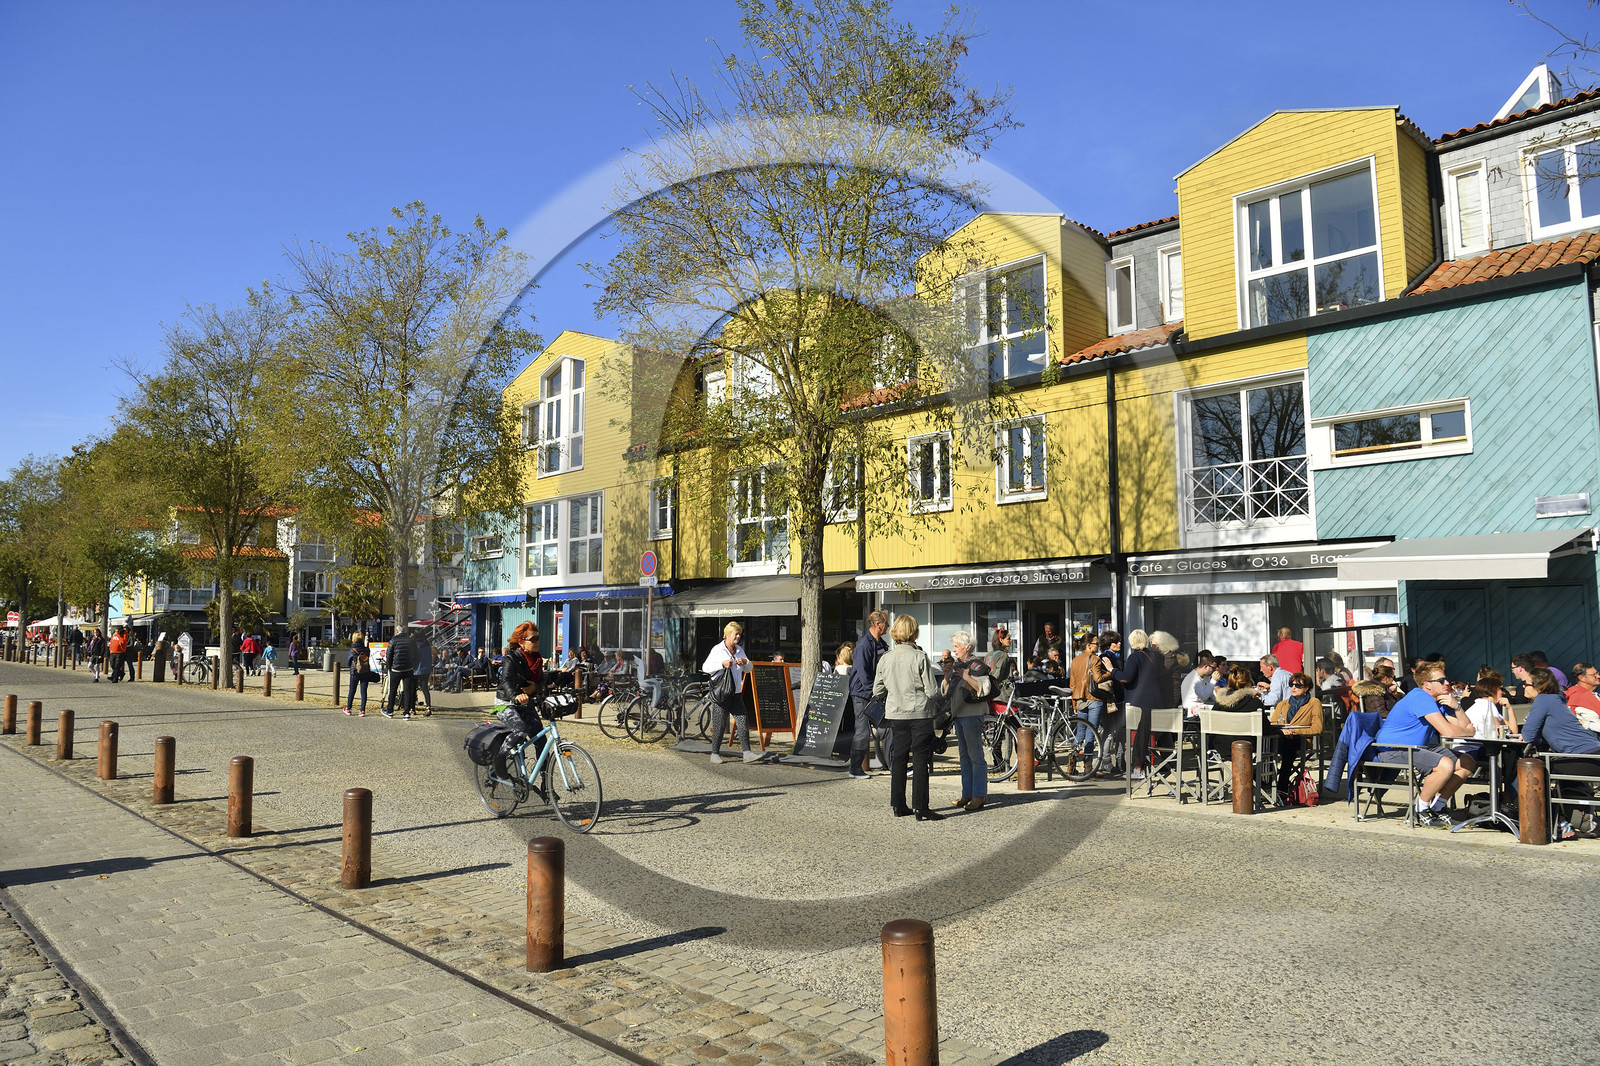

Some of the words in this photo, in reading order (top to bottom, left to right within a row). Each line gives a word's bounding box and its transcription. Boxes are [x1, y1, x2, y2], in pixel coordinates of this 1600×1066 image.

[1130, 562, 1162, 573] Café
[1177, 560, 1227, 571] Glaces
[958, 575, 982, 587] quai
[985, 574, 1029, 584] George
[1032, 571, 1084, 582] Simenon
